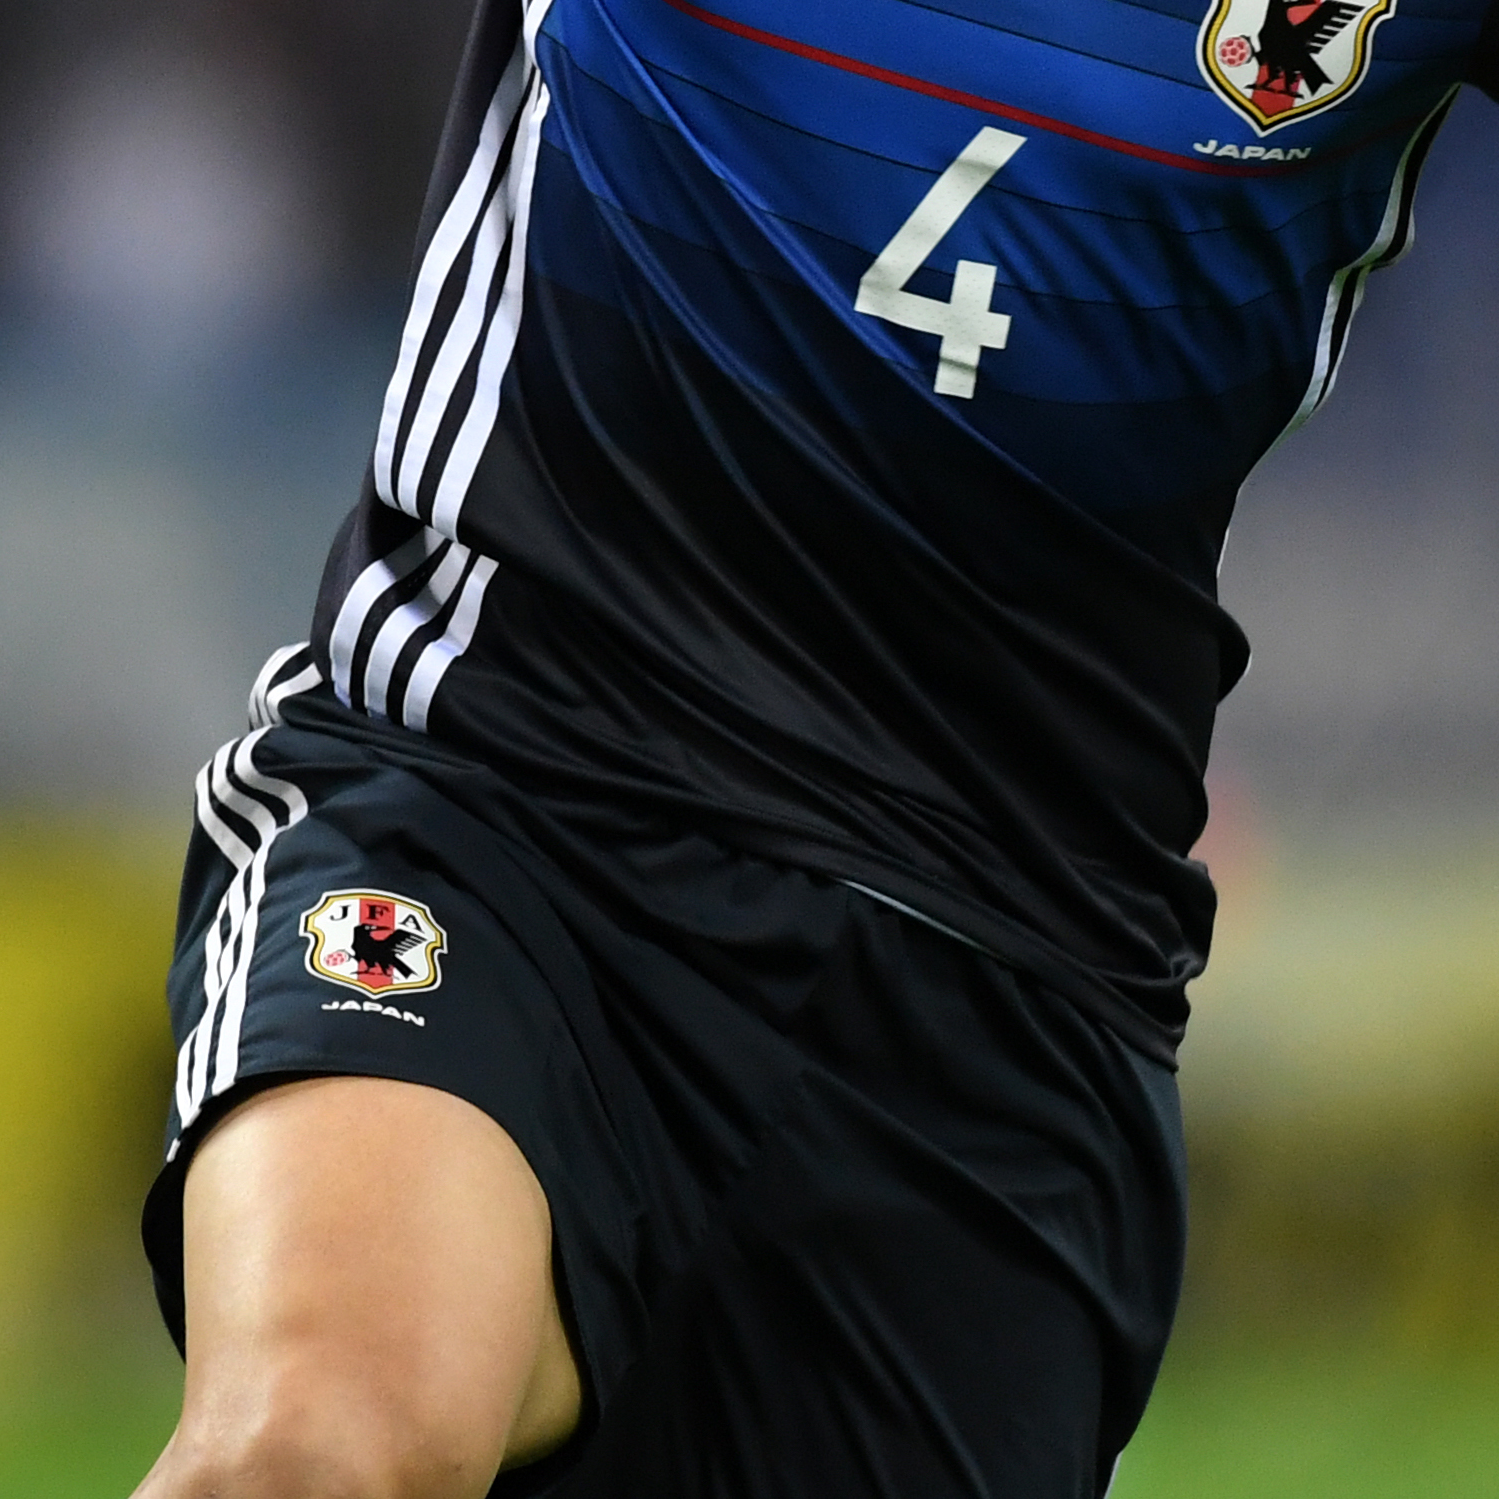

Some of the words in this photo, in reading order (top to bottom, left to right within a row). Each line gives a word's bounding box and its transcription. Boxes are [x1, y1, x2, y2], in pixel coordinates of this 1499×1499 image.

[1193, 139, 1311, 160] JAPAN
[854, 126, 1028, 399] 4
[329, 904, 426, 935] JFA
[321, 1000, 425, 1027] JAPAN
